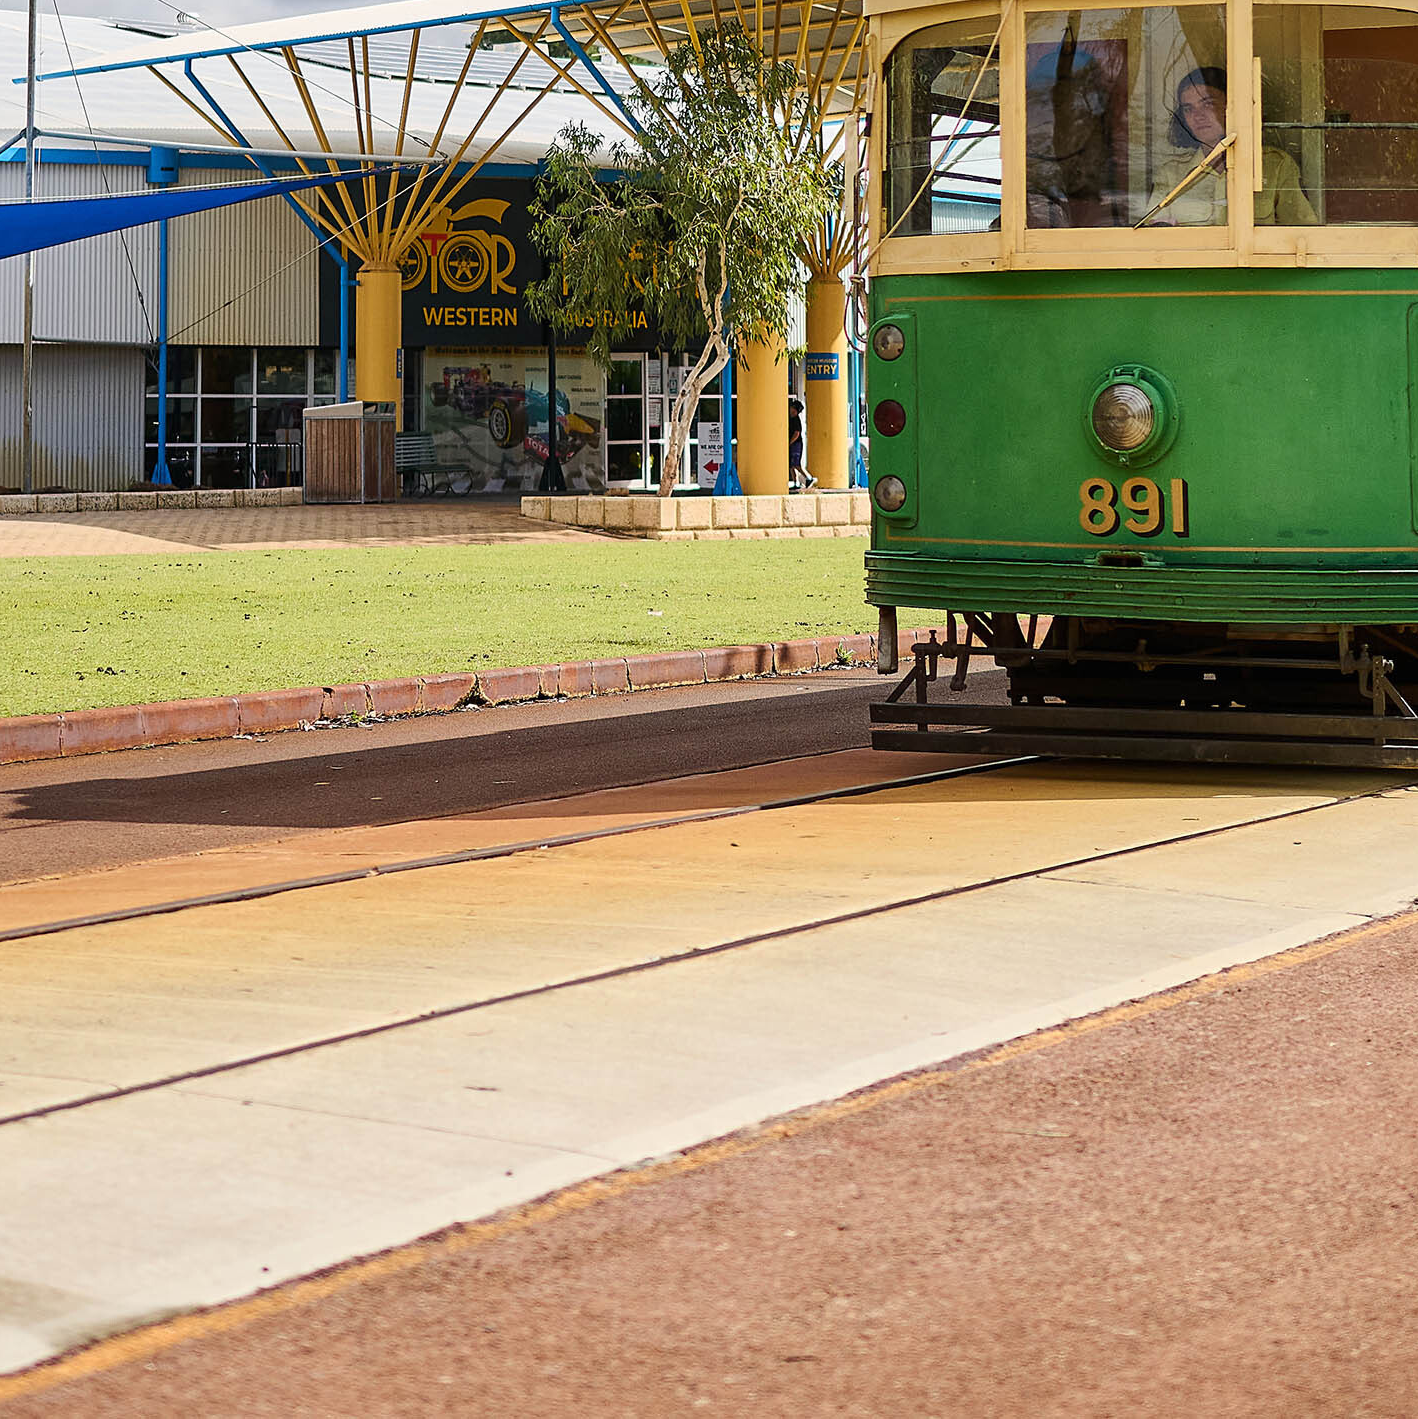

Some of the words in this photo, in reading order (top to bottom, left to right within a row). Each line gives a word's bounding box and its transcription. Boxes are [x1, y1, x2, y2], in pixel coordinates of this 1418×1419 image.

[422, 307, 518, 326] WESTERN
[806, 364, 837, 375] ENTRY
[1079, 477, 1189, 538] 891
